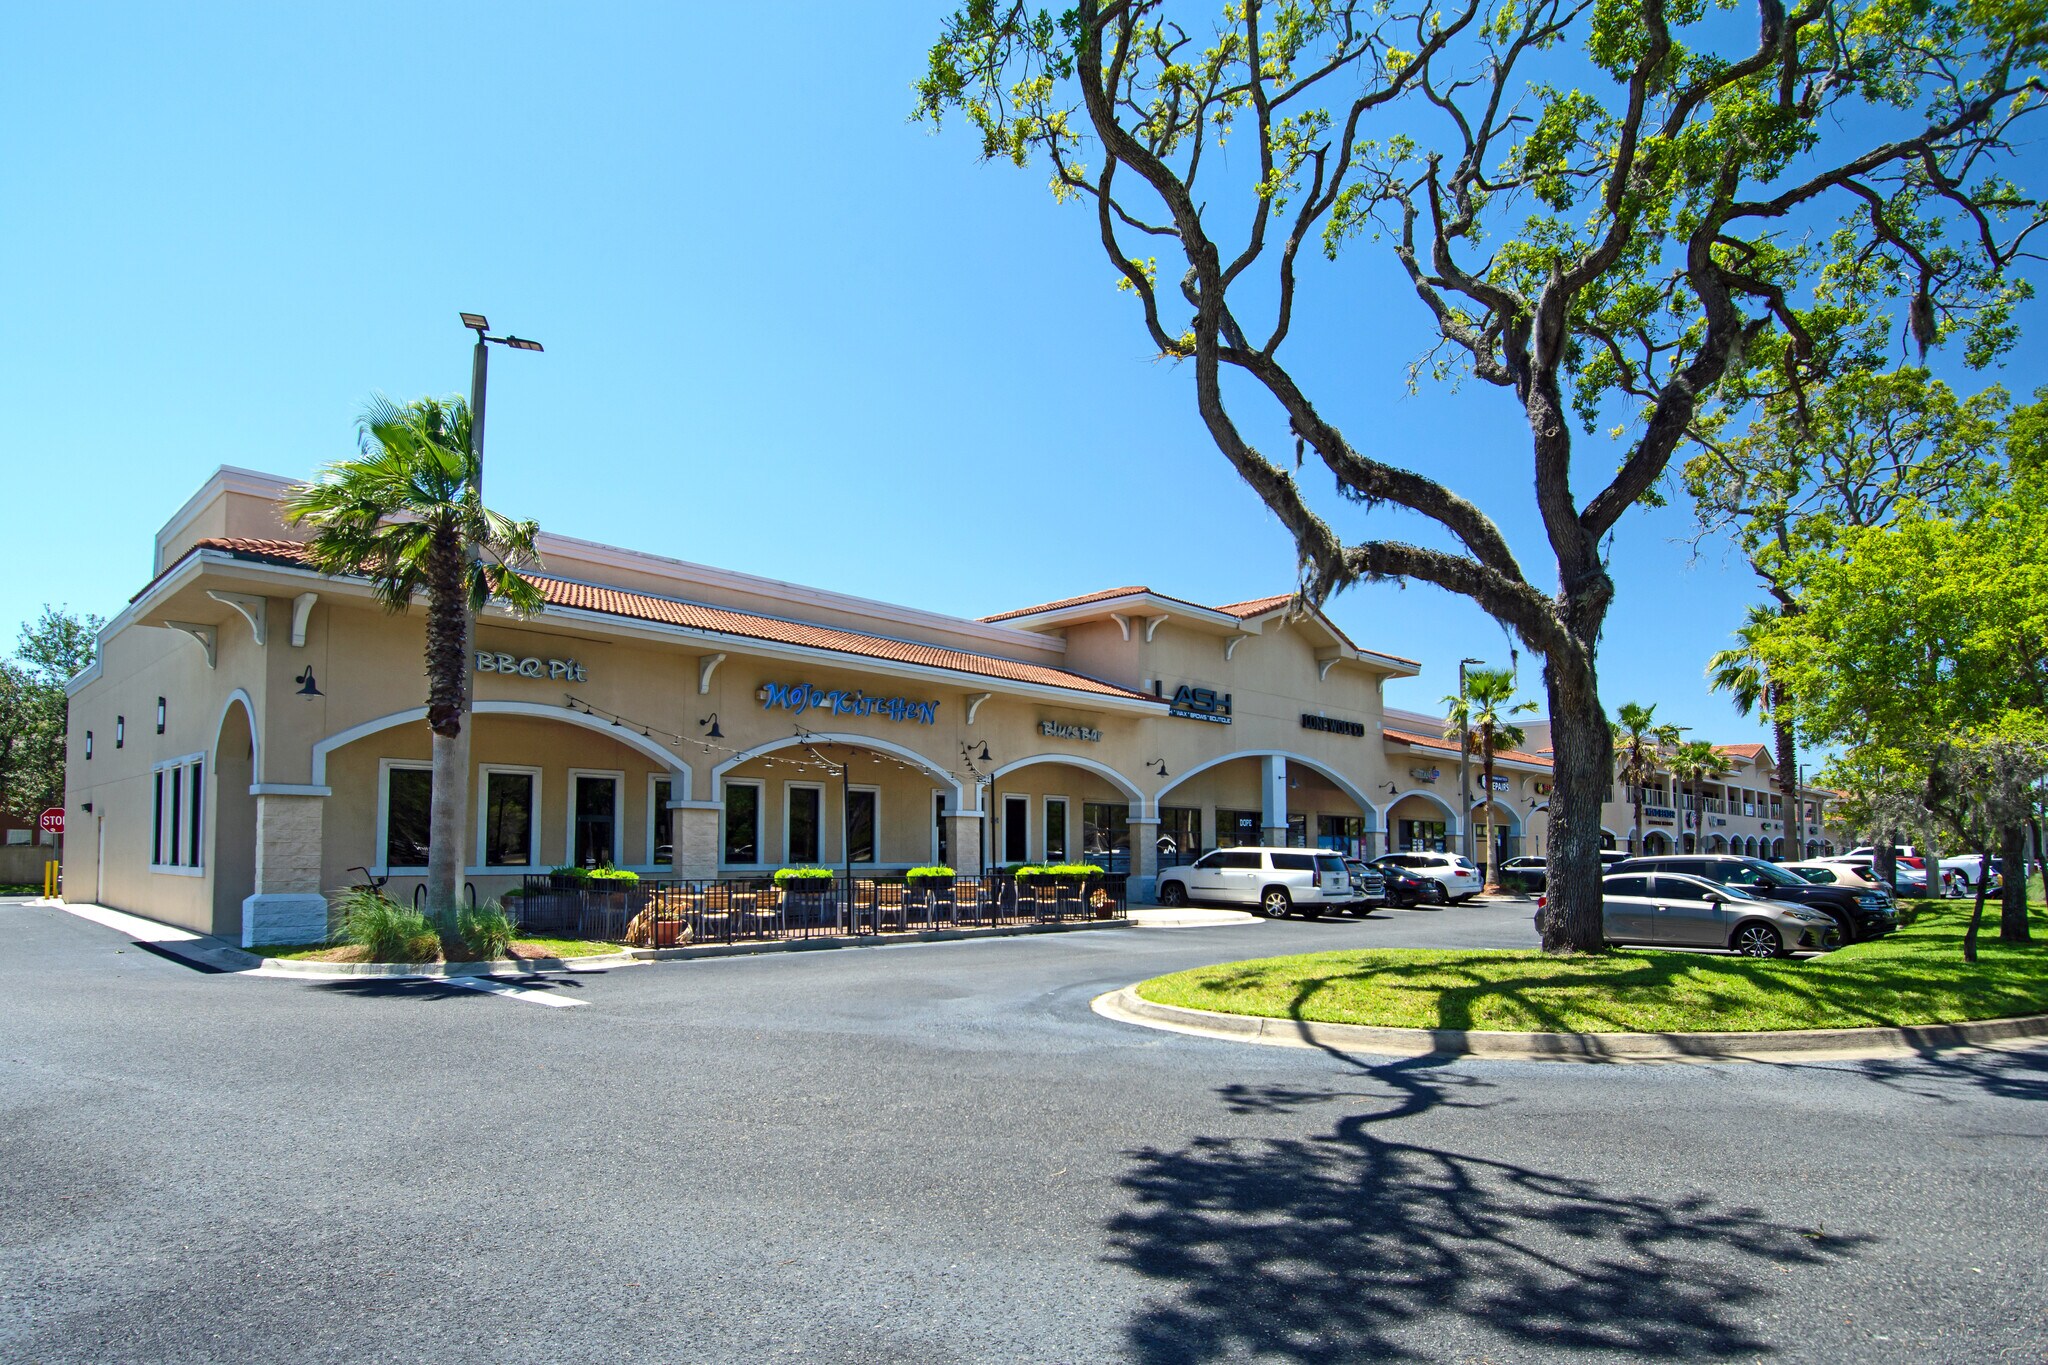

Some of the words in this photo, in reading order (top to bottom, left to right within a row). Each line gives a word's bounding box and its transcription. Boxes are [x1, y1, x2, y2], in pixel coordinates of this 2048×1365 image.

[474, 650, 544, 678] BBQ
[548, 658, 587, 682] Pit
[43, 815, 65, 826] STO
